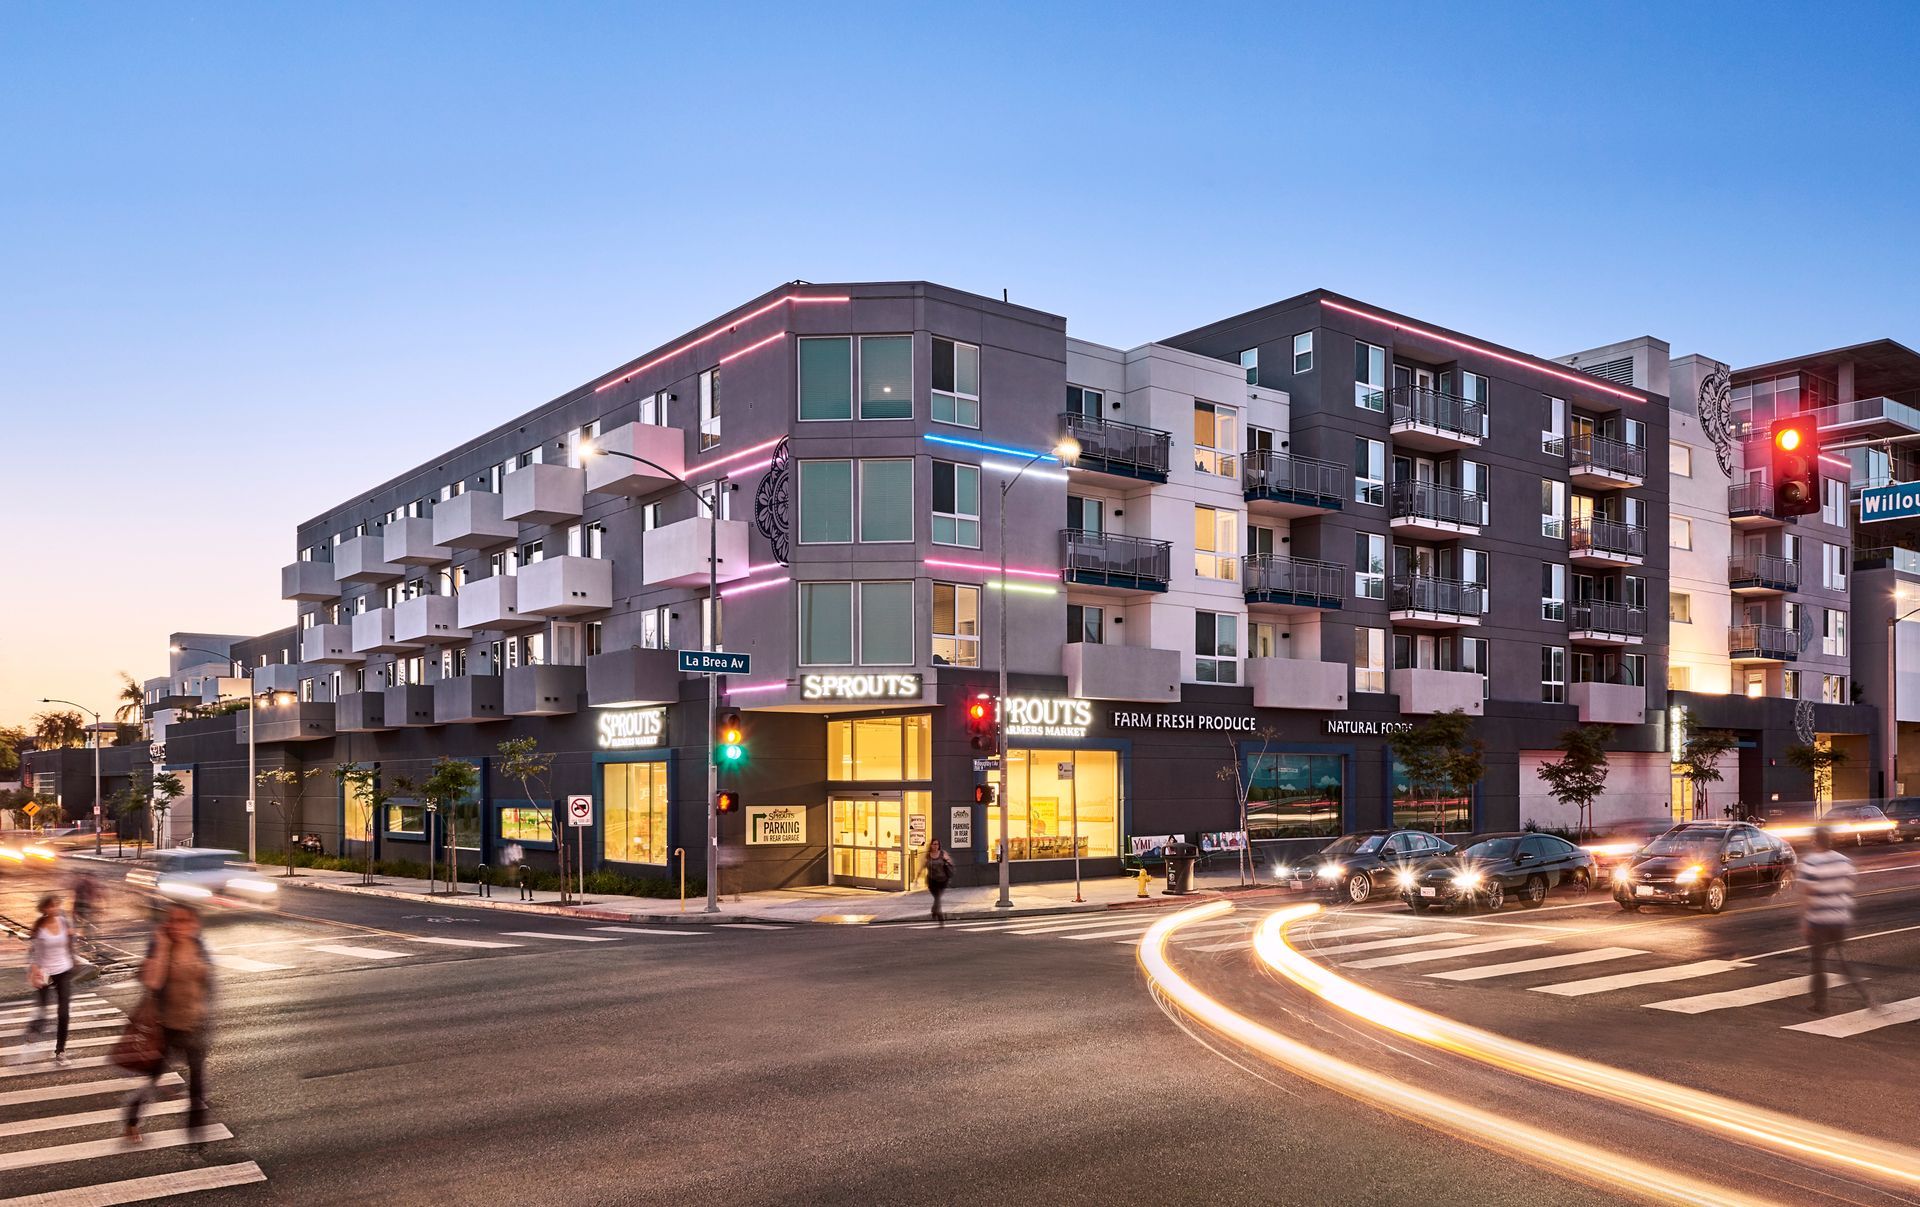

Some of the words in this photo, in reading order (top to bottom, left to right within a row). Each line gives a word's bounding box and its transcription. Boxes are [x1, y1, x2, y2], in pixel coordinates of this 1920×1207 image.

[686, 655, 699, 666] La
[702, 656, 727, 667] Brea
[731, 657, 744, 668] Av
[803, 675, 917, 698] SPROUTS
[995, 697, 1092, 726] PROUTS
[599, 711, 661, 746] SPROUTS
[1114, 712, 1151, 727] FARM
[1156, 713, 1194, 729] FRESH
[1198, 715, 1256, 730] PRODUCE
[1328, 720, 1378, 734] NATURAL
[1044, 725, 1086, 737] MARKET
[763, 821, 800, 834] PARKING
